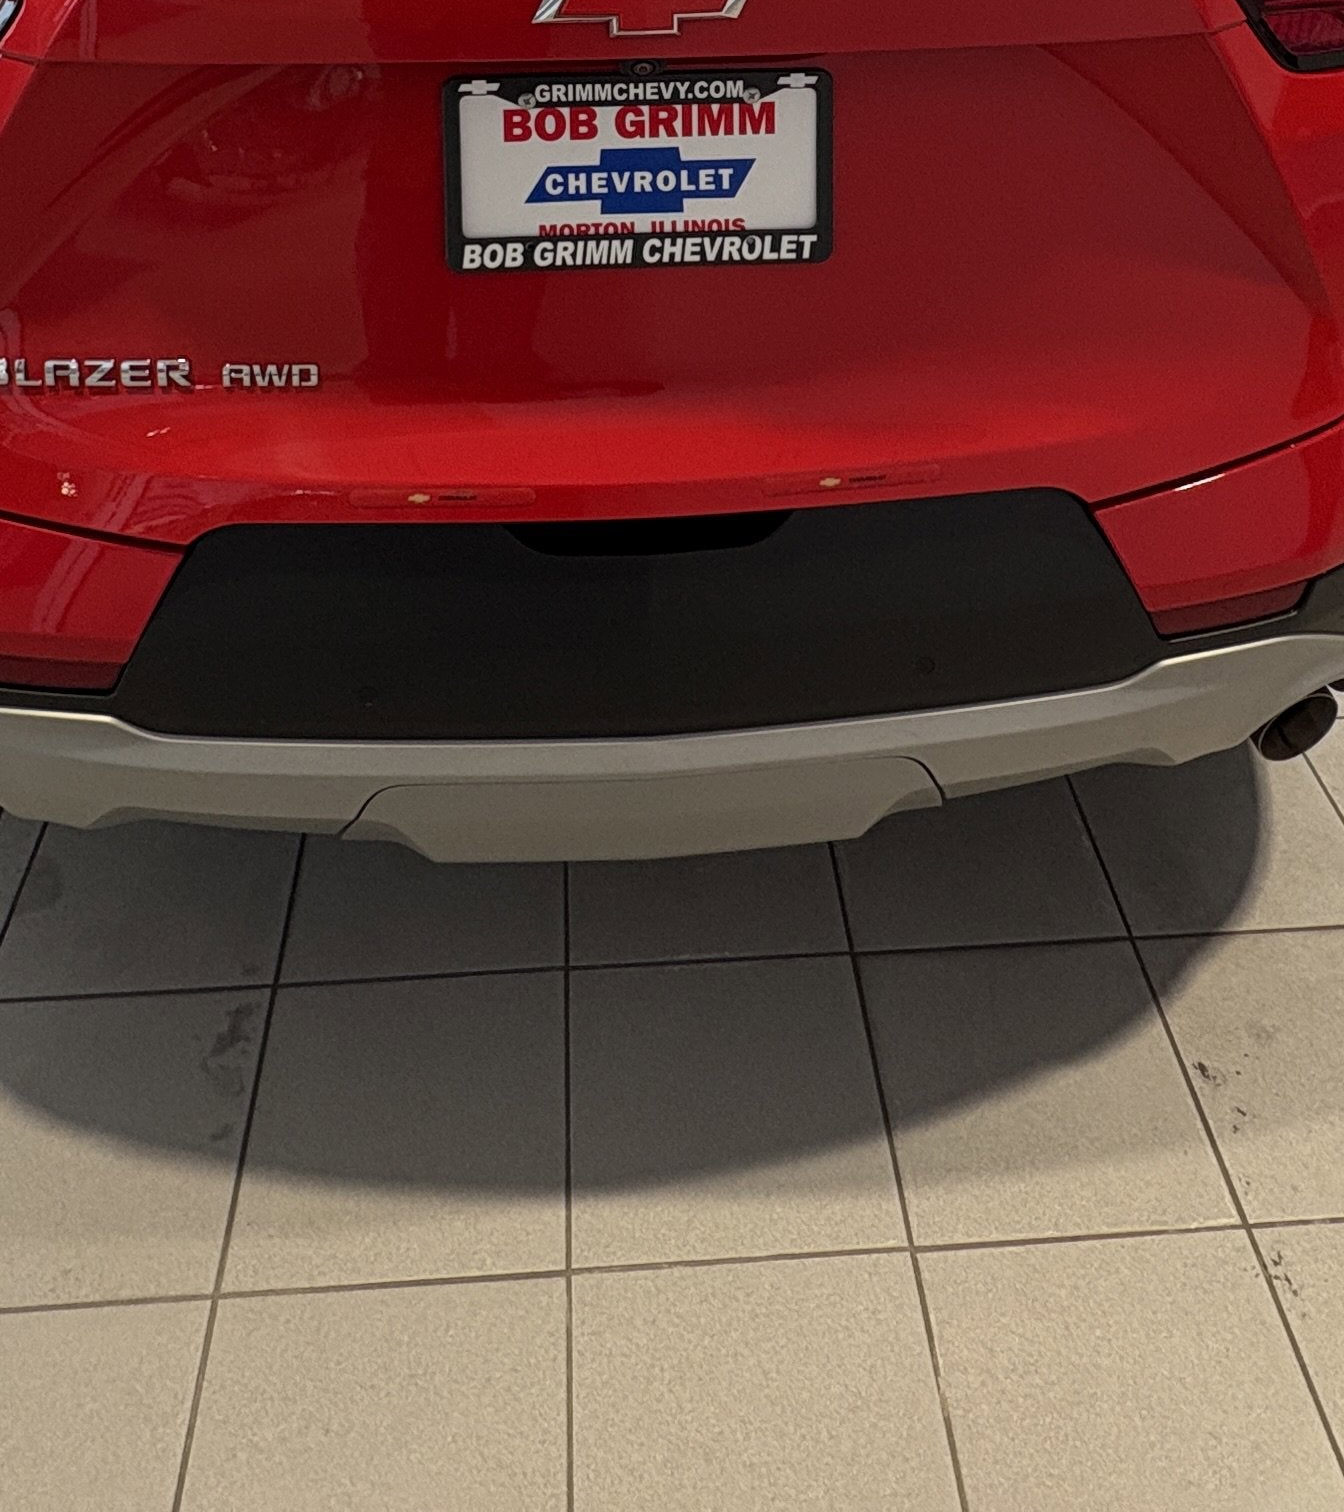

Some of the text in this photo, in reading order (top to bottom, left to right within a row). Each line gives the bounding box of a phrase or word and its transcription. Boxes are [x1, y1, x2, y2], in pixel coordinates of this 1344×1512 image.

[534, 80, 745, 102] GRIMMCHEVY.COM
[503, 101, 776, 143] BOB GRIMM
[544, 168, 734, 196] CHEVROLET
[538, 221, 635, 238] MORTON
[462, 235, 818, 269] BOB GRIMM CHEVROLET
[221, 363, 320, 388] AWD
